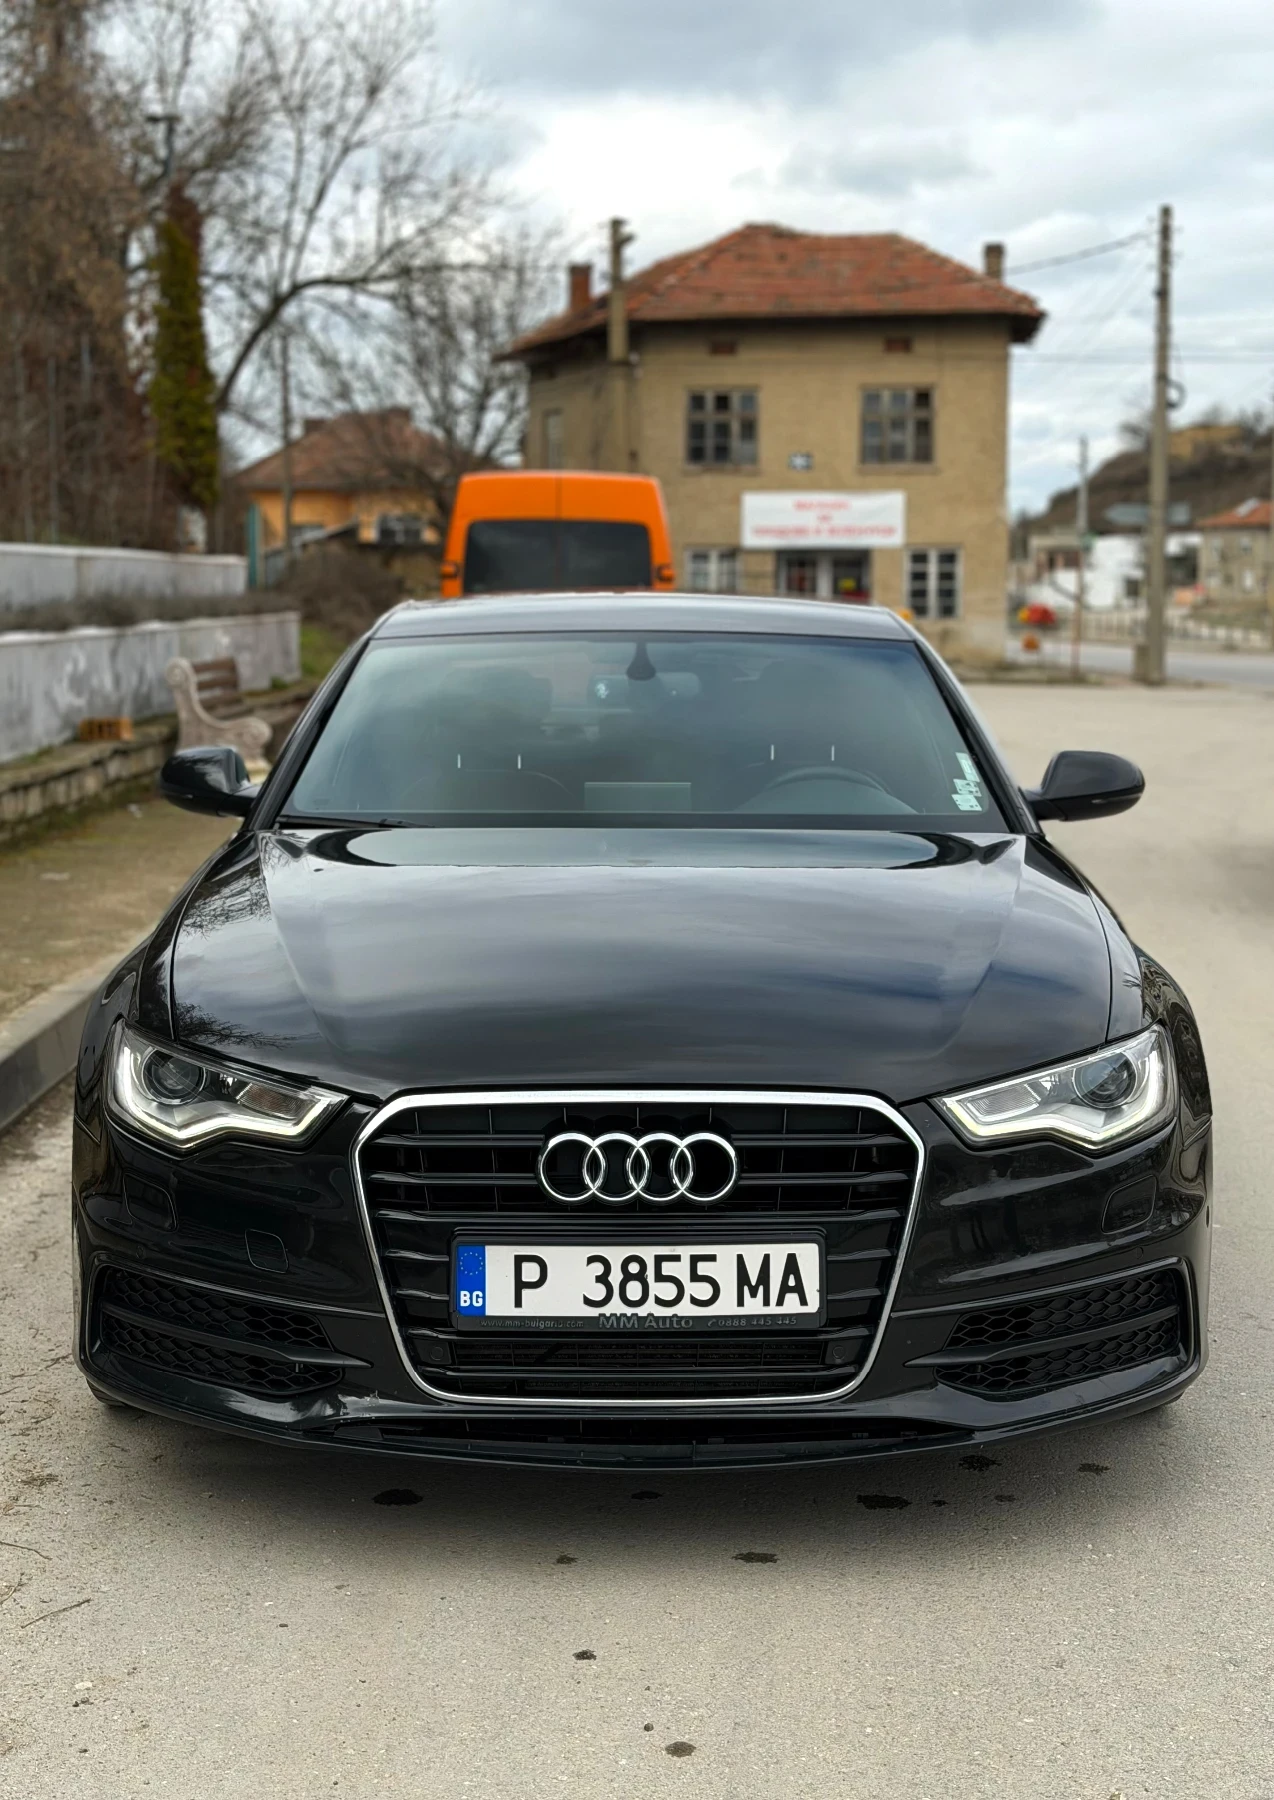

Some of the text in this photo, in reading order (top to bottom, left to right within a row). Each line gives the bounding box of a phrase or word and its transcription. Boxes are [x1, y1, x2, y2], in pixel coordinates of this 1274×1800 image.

[514, 1253, 809, 1308] P 3855 MA
[460, 1290, 483, 1308] BG
[598, 1312, 693, 1329] MM Auto
[718, 1318, 747, 1327] 0888
